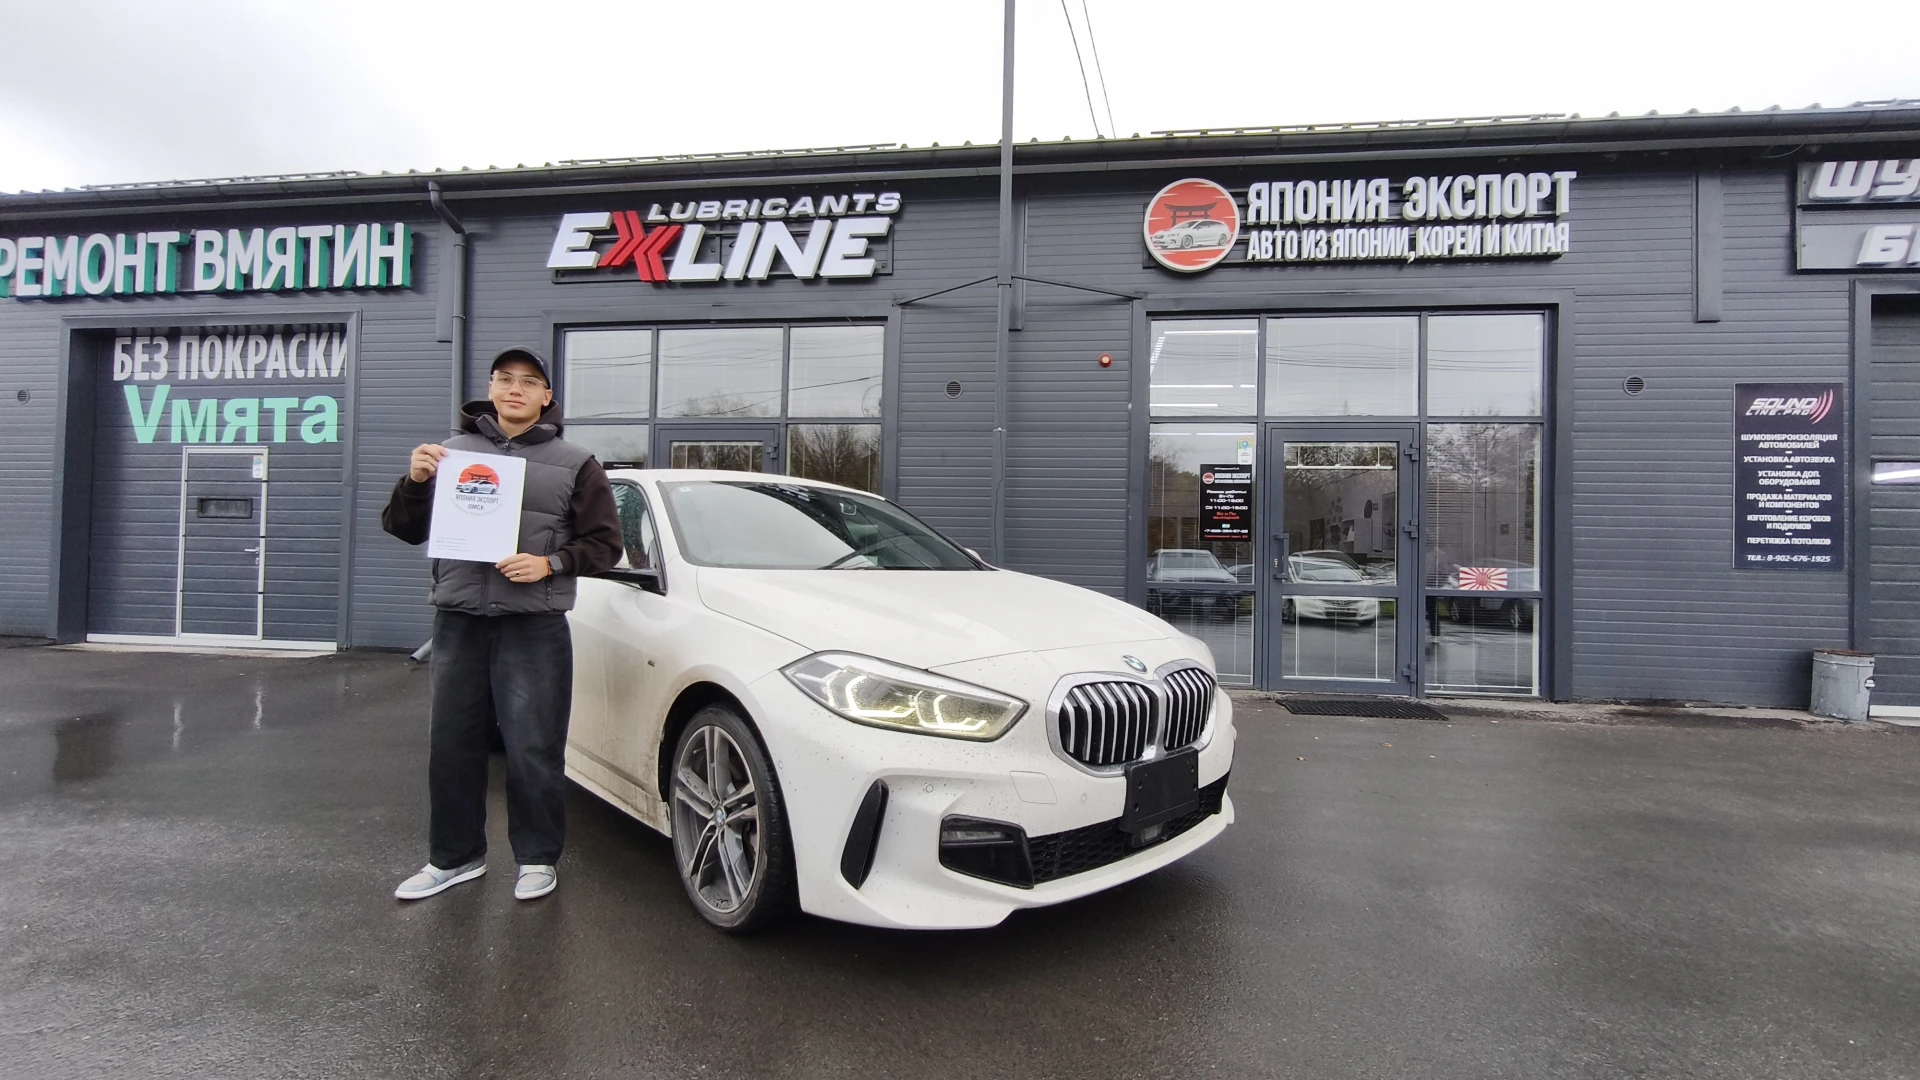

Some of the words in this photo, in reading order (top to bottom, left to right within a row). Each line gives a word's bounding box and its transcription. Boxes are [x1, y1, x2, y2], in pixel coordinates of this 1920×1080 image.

[1808, 158, 1920, 200] ШУ
[1247, 178, 1389, 225] ЯПОНИЯ
[1403, 171, 1577, 220] ЭКСПОРТ
[648, 192, 901, 223] LUBRICANTS
[546, 210, 893, 282] EXLINE
[1247, 229, 1299, 262] АВТО
[1300, 228, 1328, 260] ИЗ
[1330, 226, 1416, 264] ЯПОНИИ,
[1416, 224, 1483, 258] КОРЕИ
[1483, 223, 1500, 256] И
[1501, 222, 1569, 256] КИТАЯ
[194, 222, 408, 292] ВМЯТИН
[113, 336, 169, 381] БЕЗ
[178, 332, 348, 380] ПОКРАСКИ
[1750, 397, 1819, 409] SOUND
[1740, 433, 1838, 442] ШУМОВИБРОИЗОЛЯЦИЯ
[1758, 441, 1820, 449] АВТОМОБИЛЕЙ
[1743, 455, 1789, 463] УСТАНОВКА
[1757, 470, 1801, 478] УСТАНОВКА
[1801, 471, 1821, 479] ДОП.
[1758, 479, 1821, 487] ОБОРУДОВАНИЯ
[1746, 493, 1783, 501] ПРОДАЖА
[1783, 493, 1832, 501] МАТЕРИАЛОВ
[467, 503, 485, 511] ОМСК
[1746, 537, 1791, 545] ПЕРЕТЯЖКА
[1766, 554, 1831, 562] 8-902-676-1925
